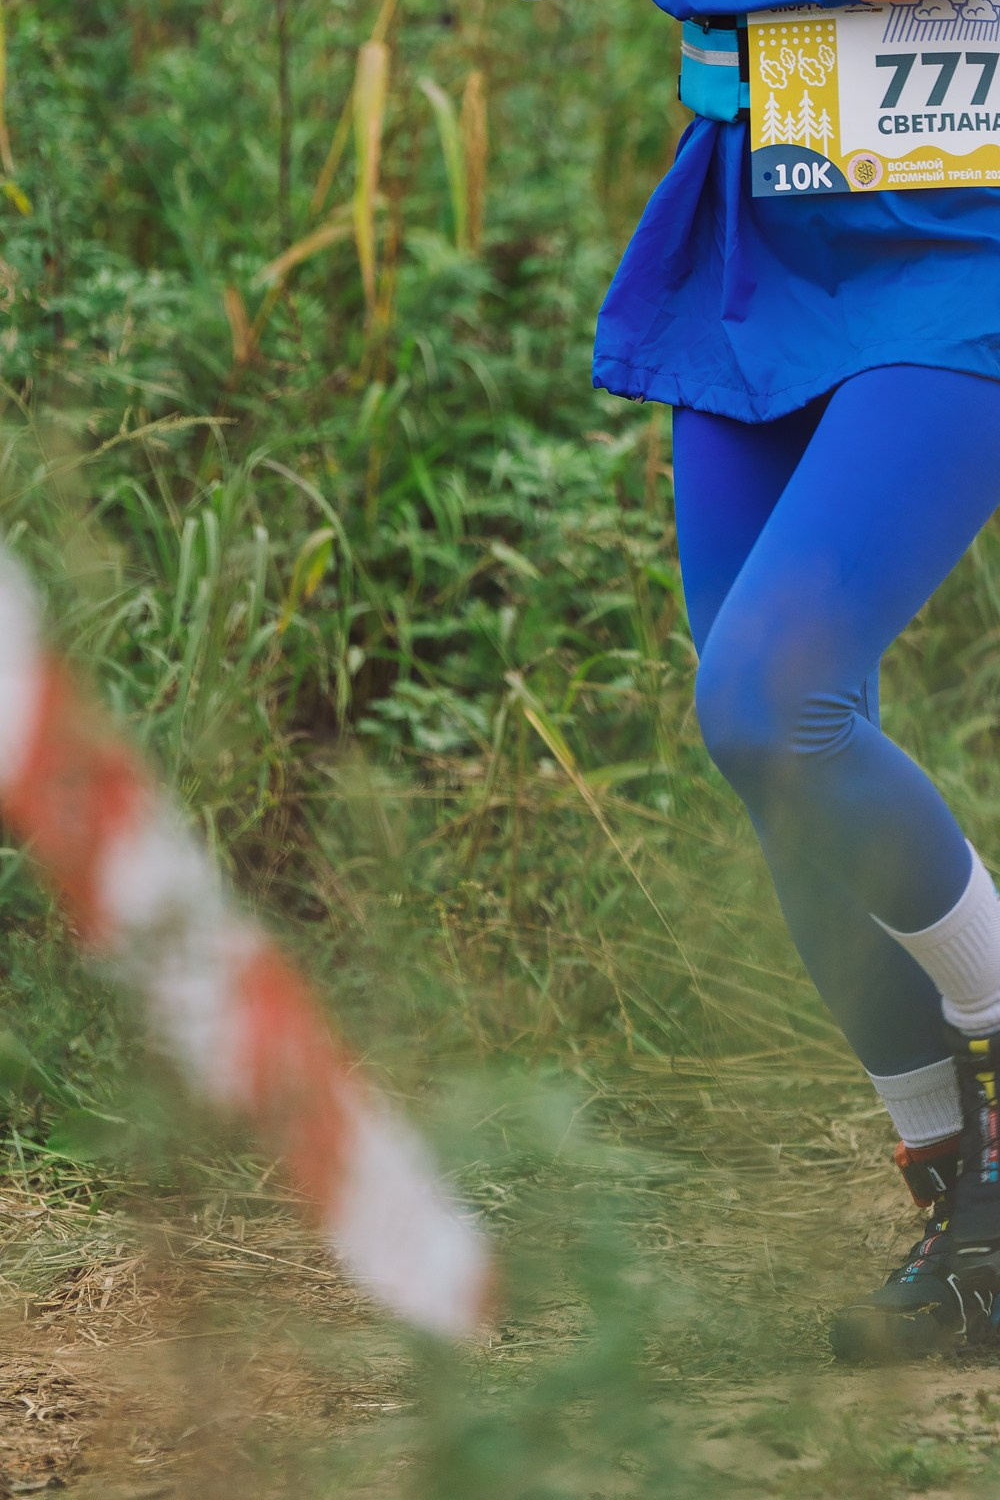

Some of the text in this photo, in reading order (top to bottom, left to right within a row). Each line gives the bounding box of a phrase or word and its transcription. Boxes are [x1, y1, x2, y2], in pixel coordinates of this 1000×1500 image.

[875, 52, 1000, 109] 777
[887, 158, 943, 171] ВОСЬМОЙ
[887, 169, 945, 183] АТОМНЫЙ
[948, 168, 982, 181] ТРЕЙЛ
